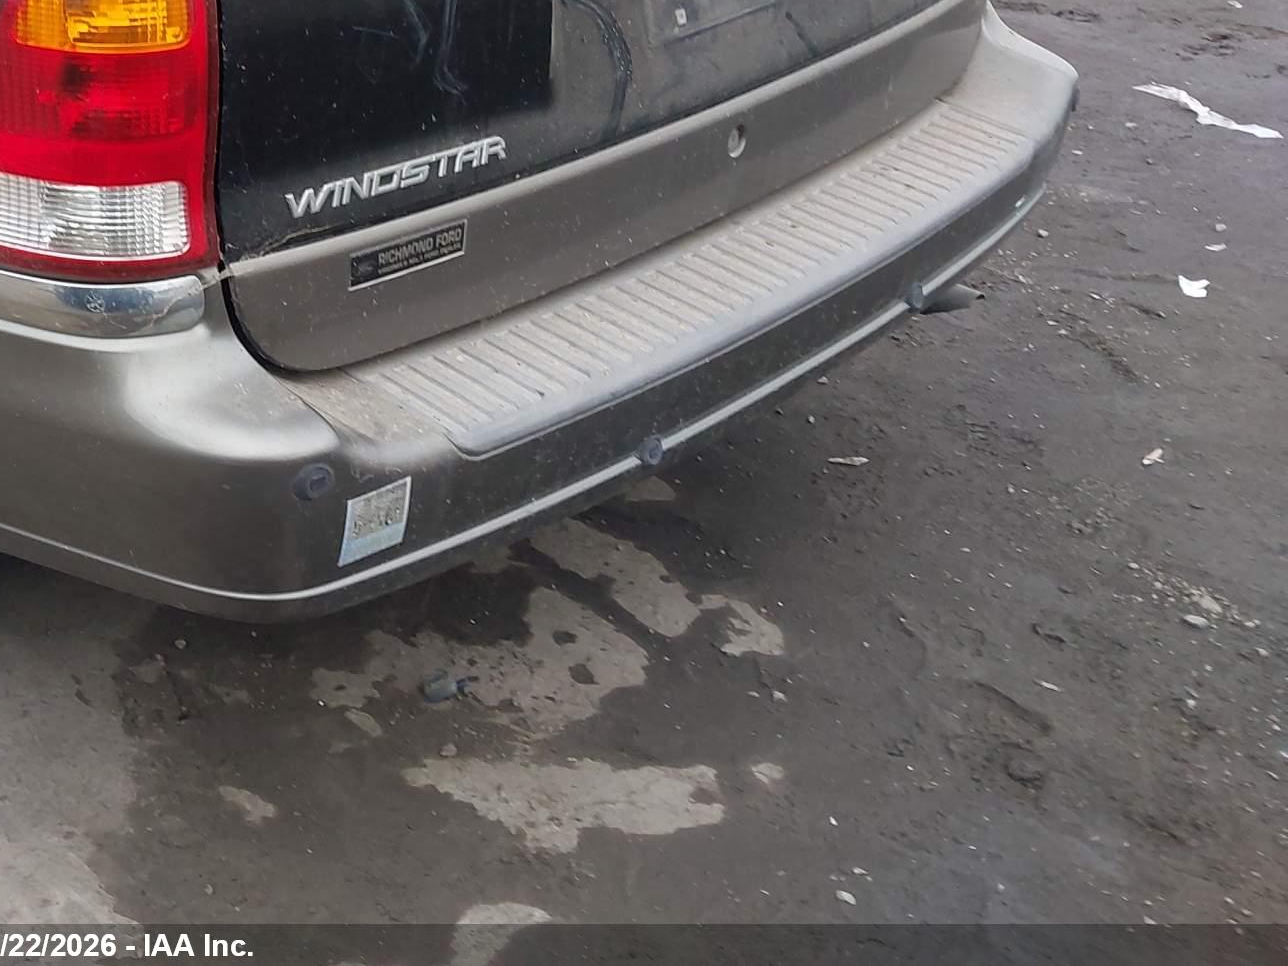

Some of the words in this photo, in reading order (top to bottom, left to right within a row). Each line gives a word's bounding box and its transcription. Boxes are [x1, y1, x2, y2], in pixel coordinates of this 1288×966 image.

[284, 135, 507, 219] WINDSTAR
[377, 237, 434, 267] RICHMOND
[435, 228, 463, 249] FORD
